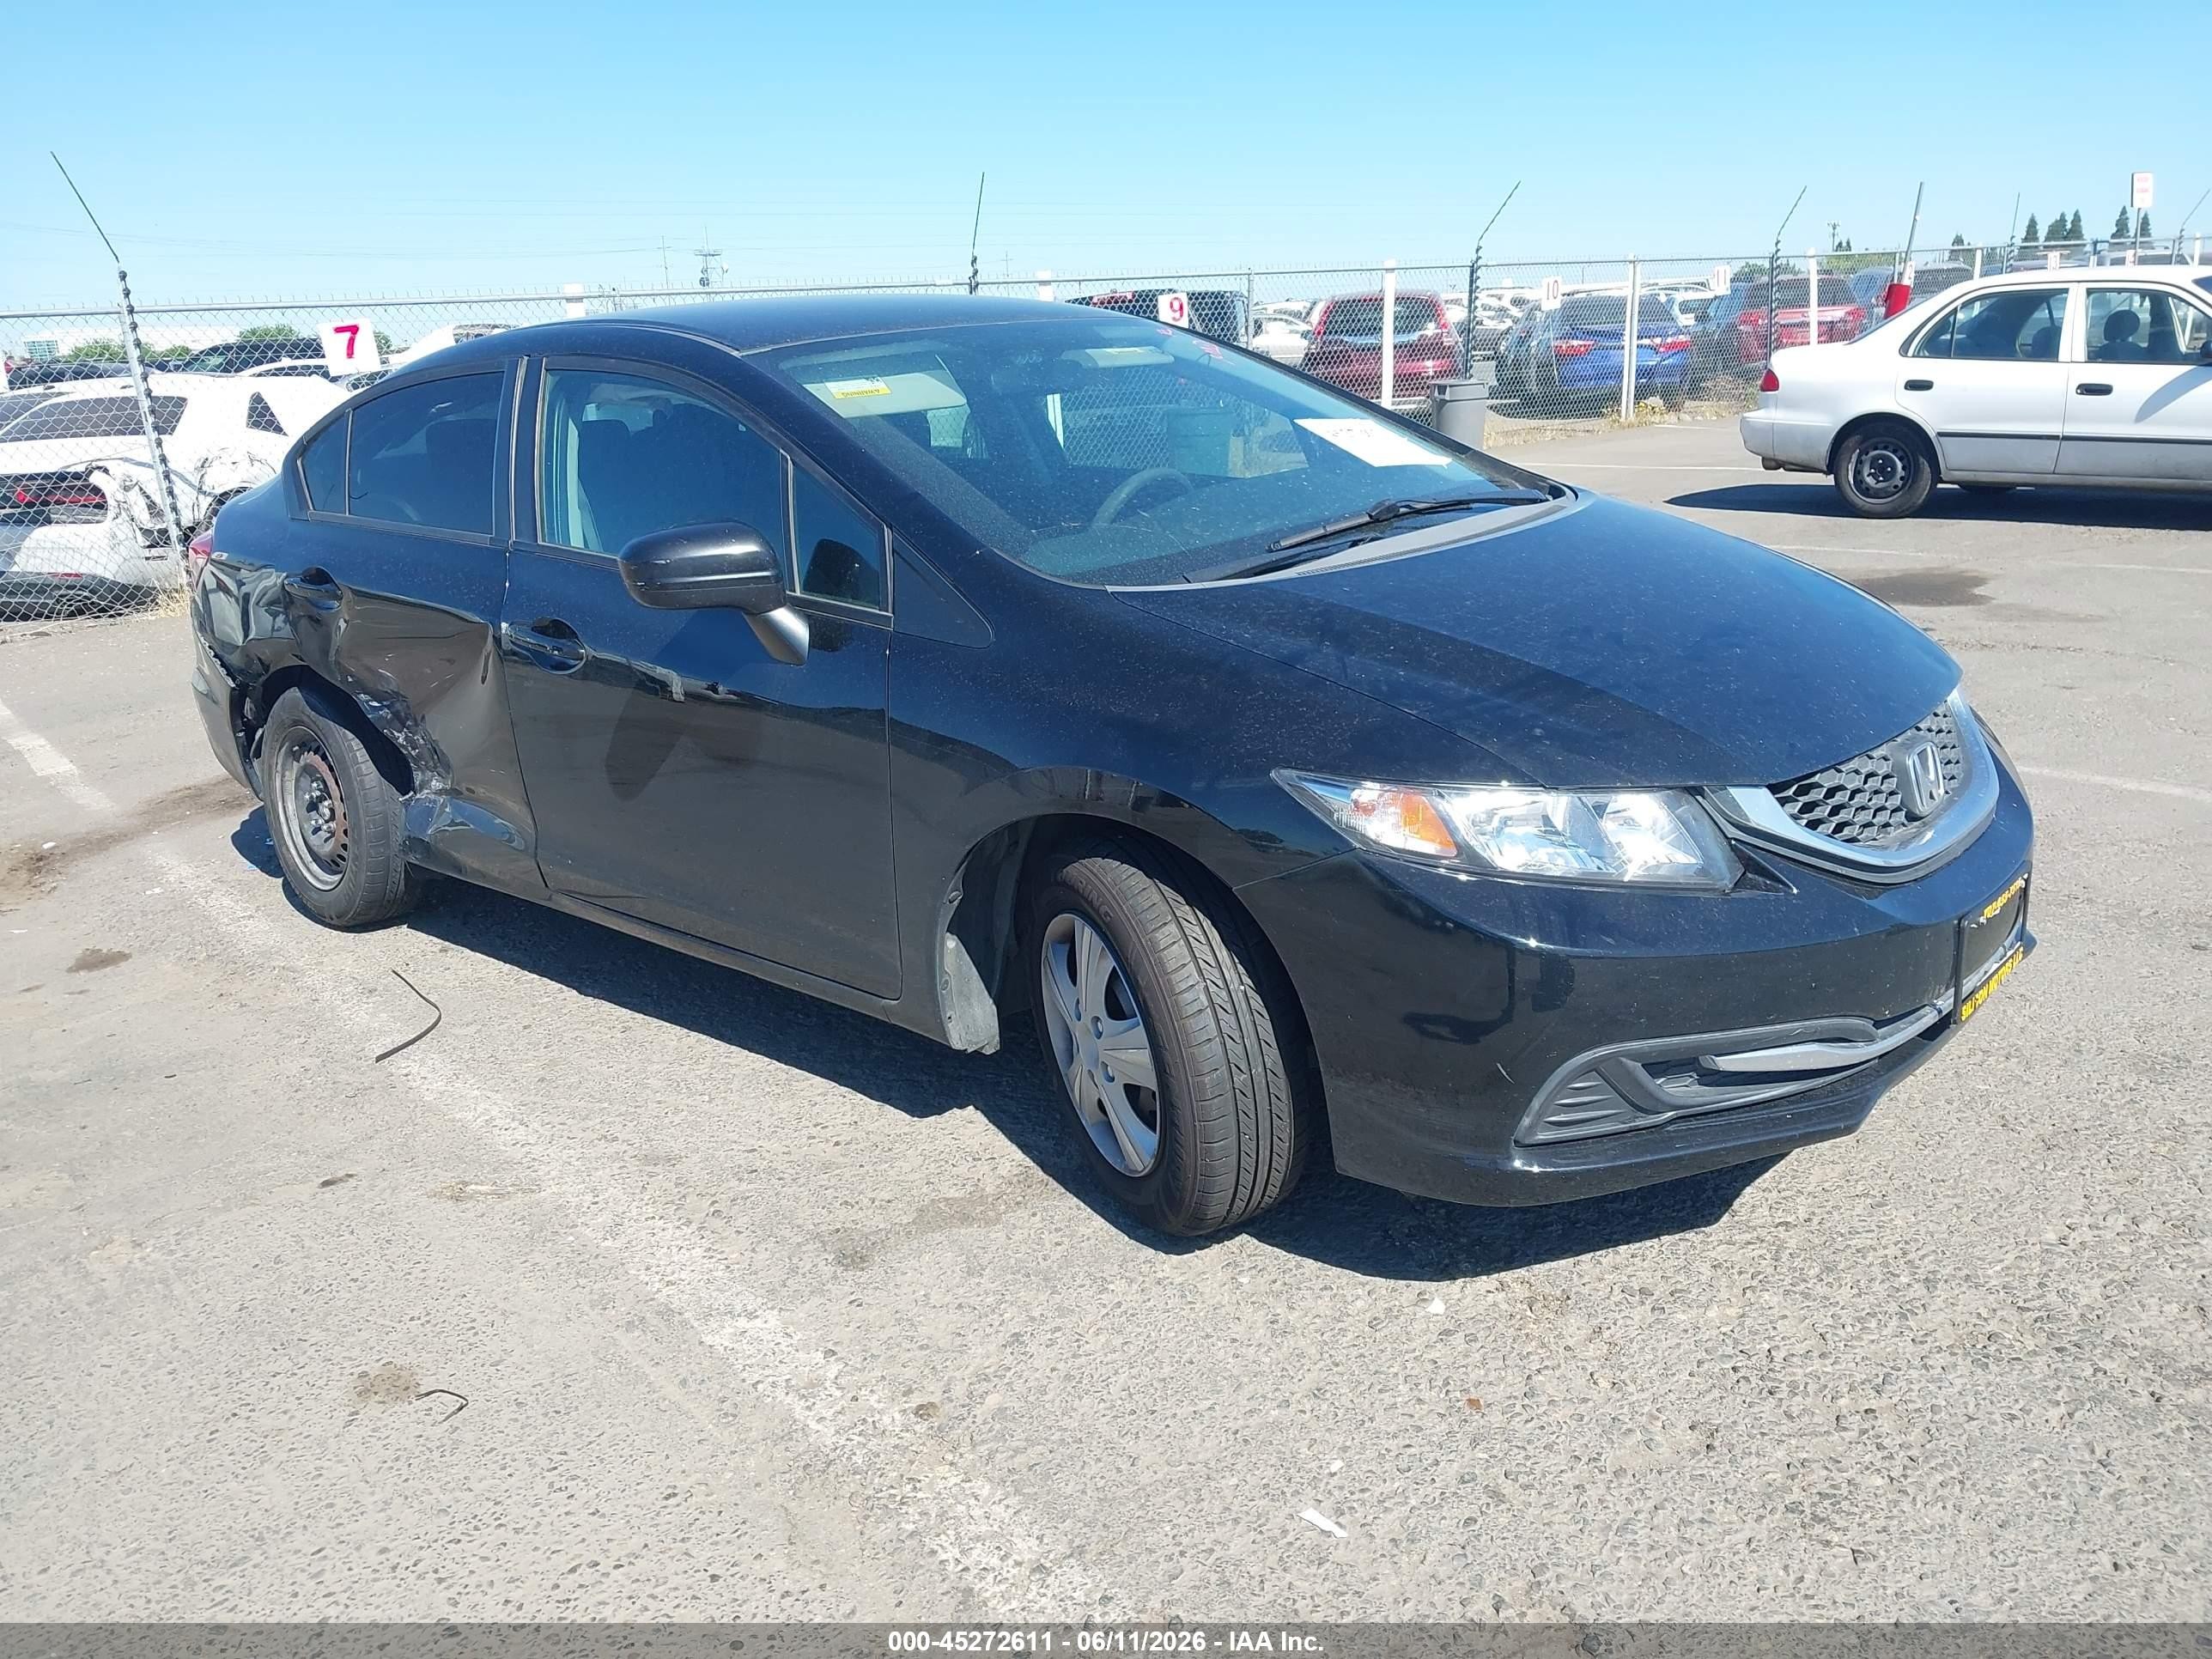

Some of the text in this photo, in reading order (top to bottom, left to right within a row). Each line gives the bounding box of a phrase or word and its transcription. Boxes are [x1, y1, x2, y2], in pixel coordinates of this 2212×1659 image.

[1547, 279, 1559, 301] 10
[1170, 296, 1183, 322] 9
[333, 324, 360, 359] 7
